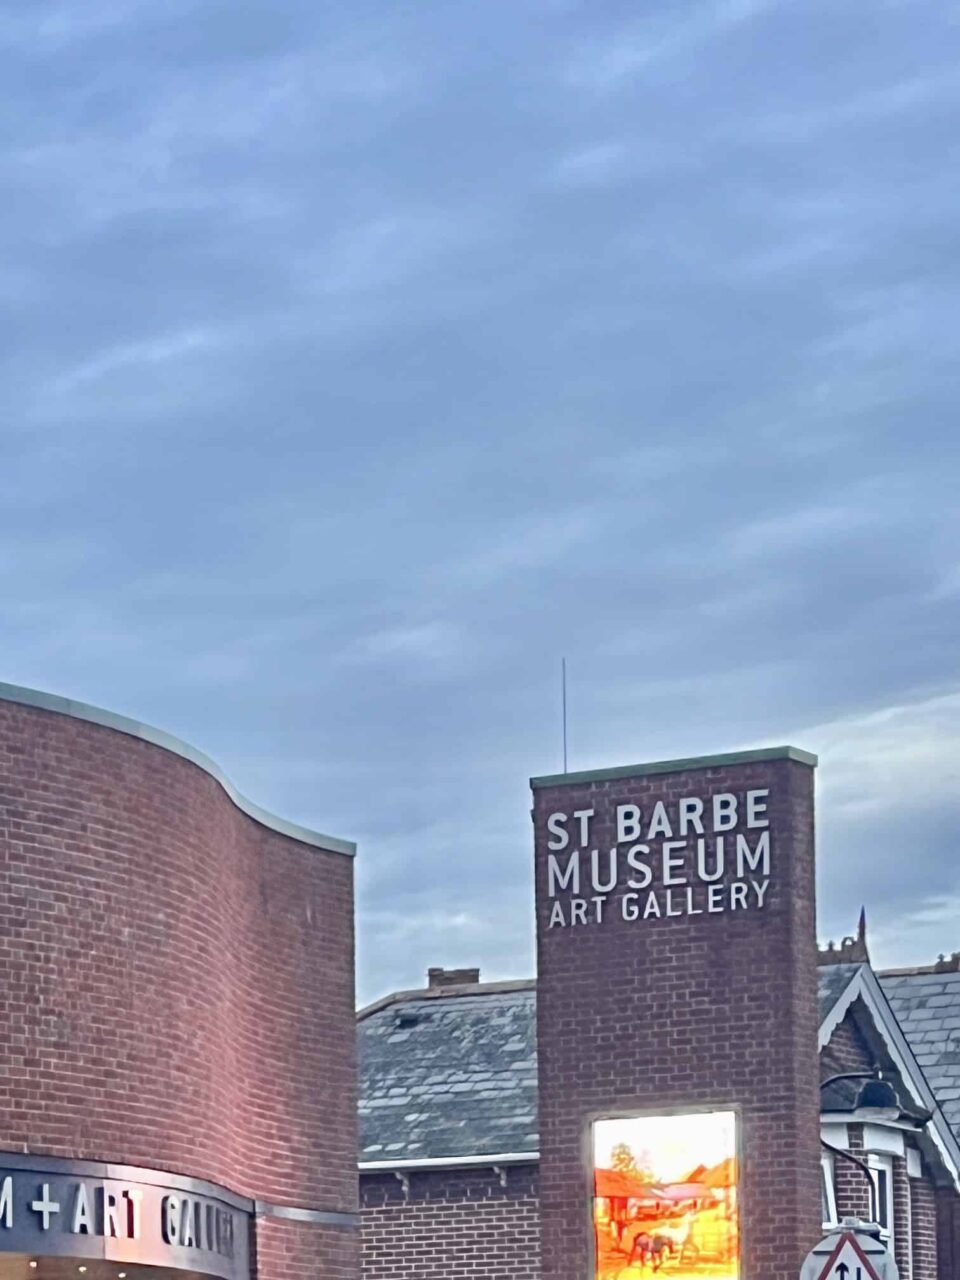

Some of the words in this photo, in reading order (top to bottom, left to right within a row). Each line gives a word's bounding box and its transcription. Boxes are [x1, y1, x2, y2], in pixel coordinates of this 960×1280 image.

[547, 809, 595, 850] ST
[616, 789, 770, 843] BARBE
[547, 831, 771, 898] MUSEUM
[548, 896, 607, 929] ART
[621, 879, 770, 921] GALLERY
[71, 1182, 144, 1239] ART
